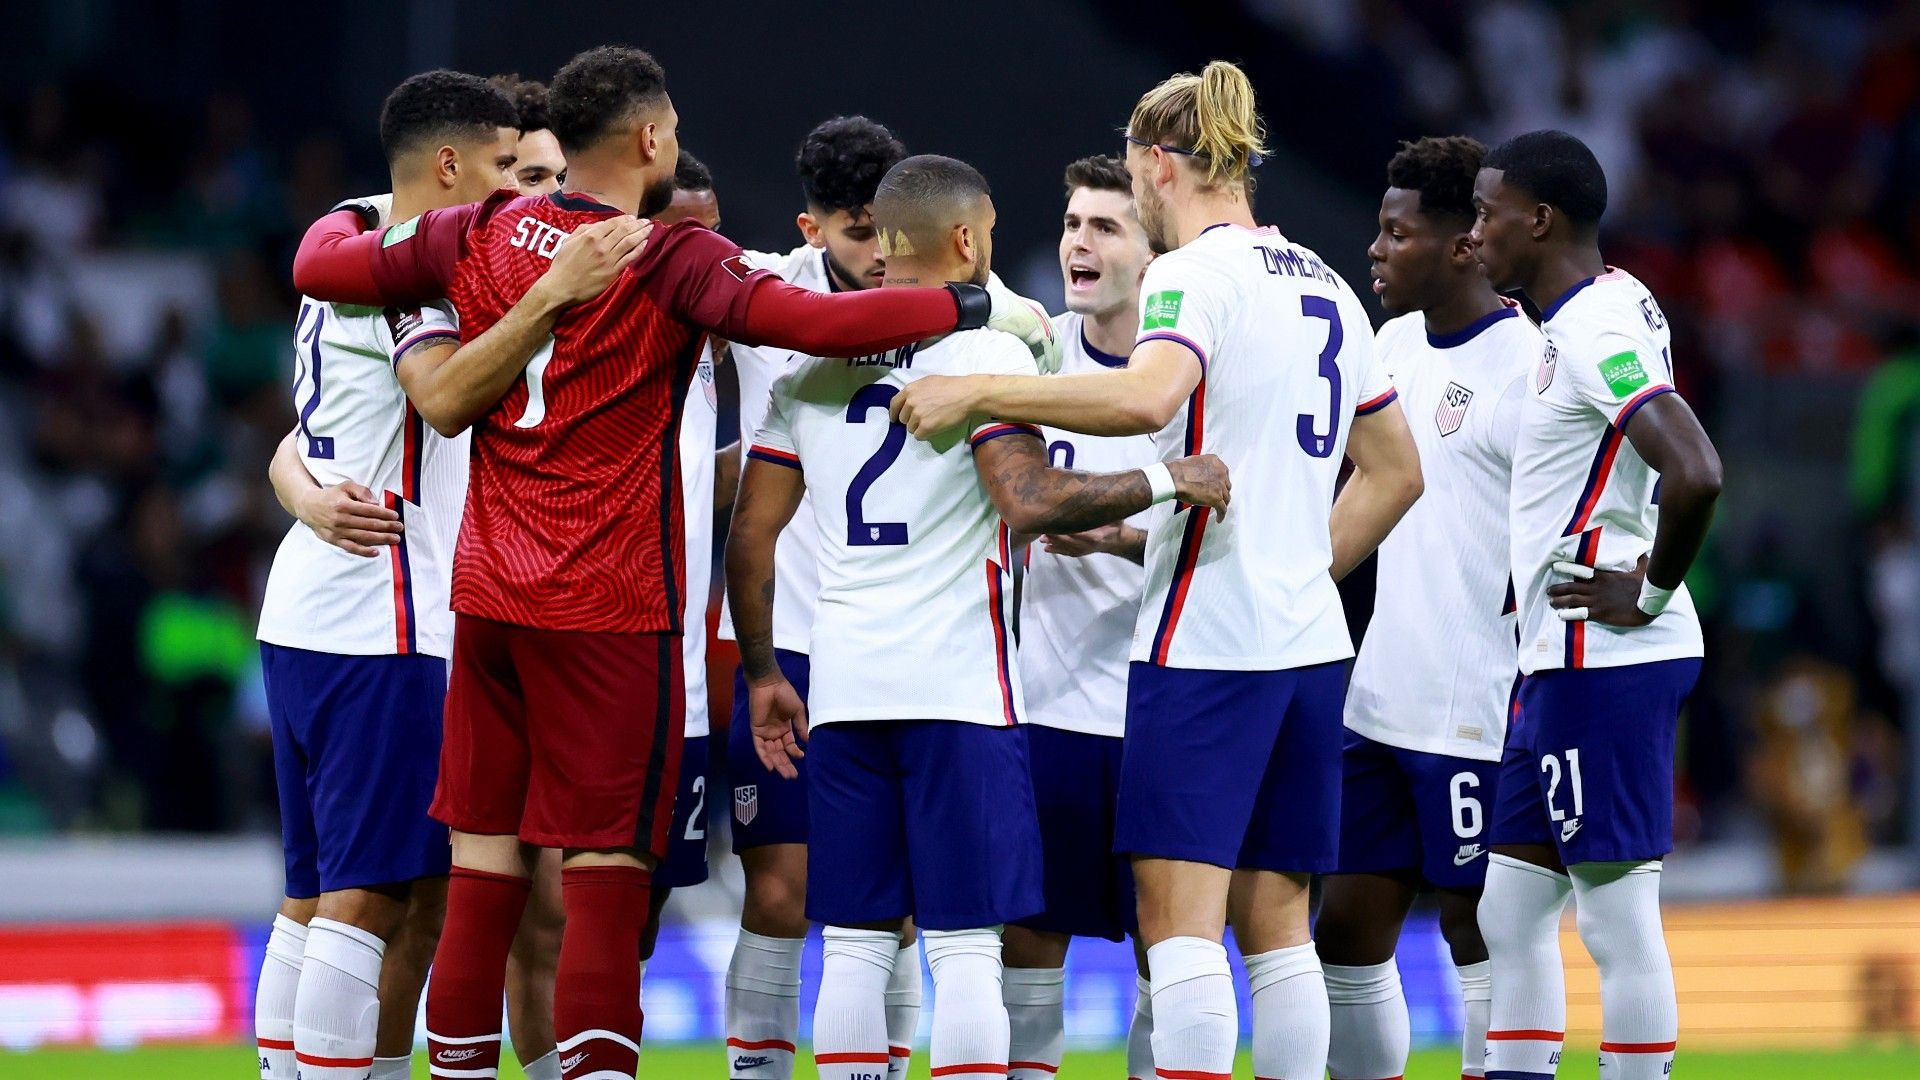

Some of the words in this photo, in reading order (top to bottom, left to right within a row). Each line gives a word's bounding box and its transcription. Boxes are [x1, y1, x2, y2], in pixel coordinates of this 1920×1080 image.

[1296, 295, 1343, 458] 3
[1446, 386, 1469, 408] USA
[846, 384, 909, 546] 2
[1541, 748, 1583, 821] 21
[736, 787, 756, 803] USA
[1450, 771, 1483, 838] 6
[1563, 818, 1579, 833] NIKE
[1458, 843, 1480, 857] NIKE
[443, 1048, 477, 1059] NIKE
[560, 1052, 583, 1068] NIKE
[737, 1056, 768, 1065] NIKE
